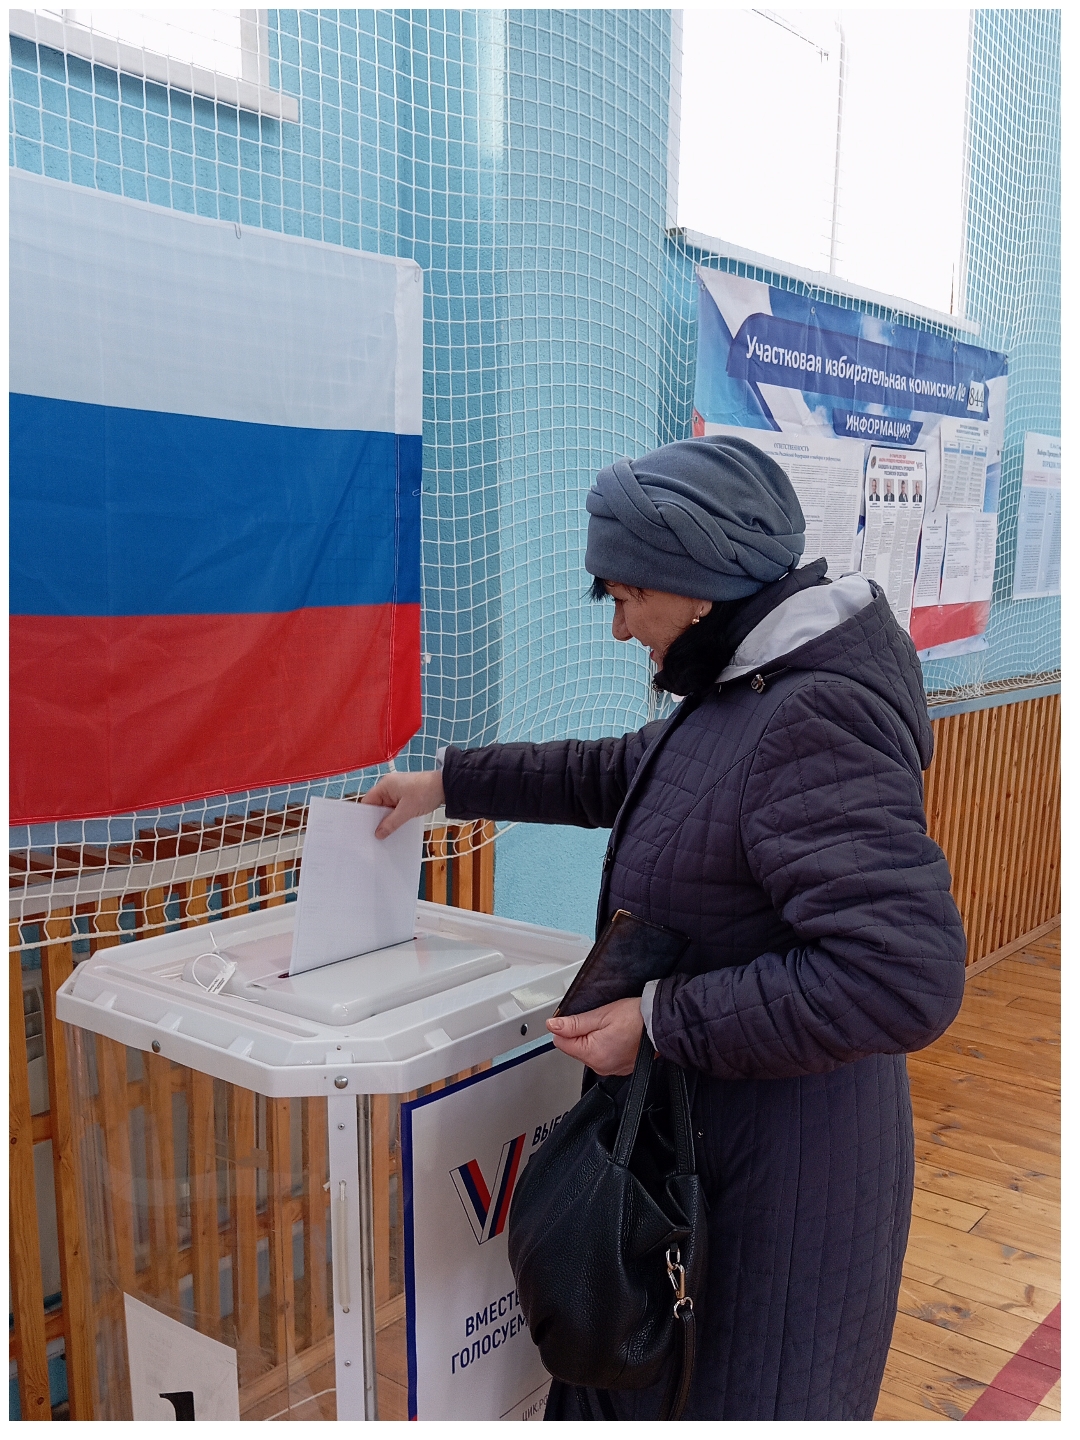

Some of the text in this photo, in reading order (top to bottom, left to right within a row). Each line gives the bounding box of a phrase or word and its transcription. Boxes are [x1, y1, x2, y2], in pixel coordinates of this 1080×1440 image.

[746, 334, 985, 408] Участковая избирательная комиссия № 844
[846, 414, 911, 440] ИНФОРМАЦИЯ
